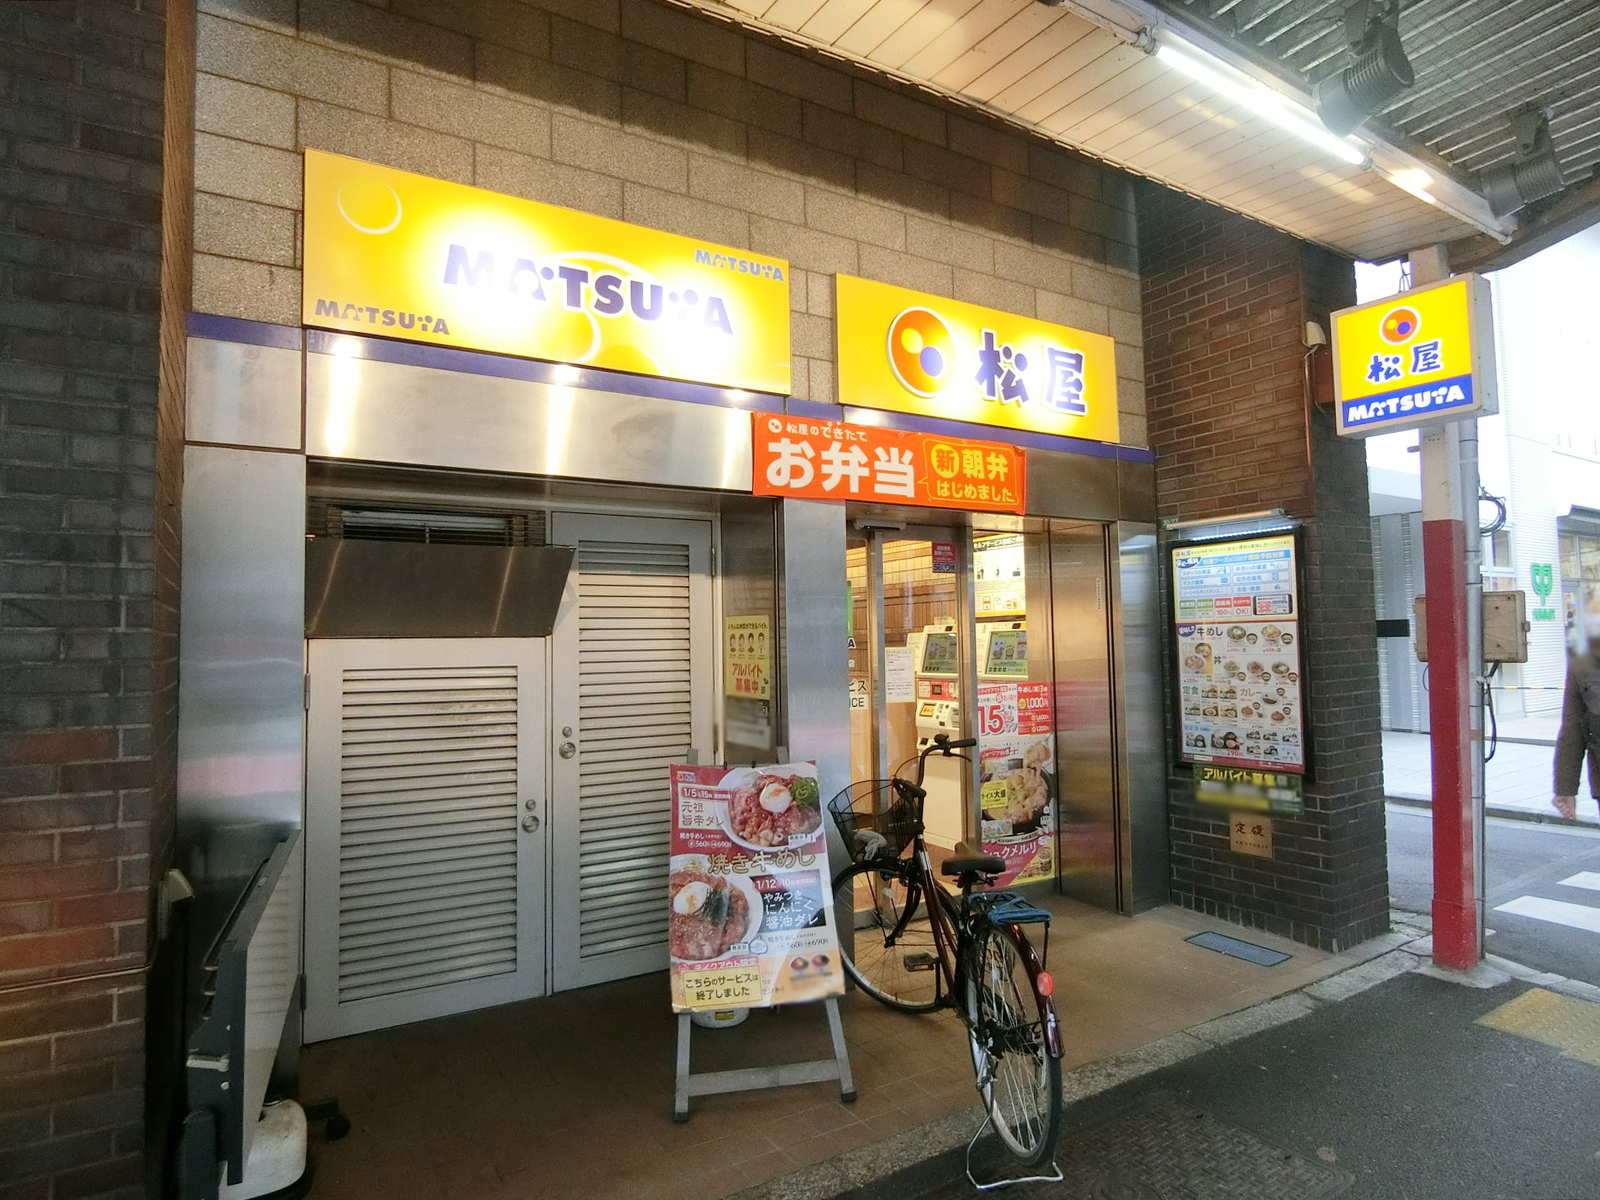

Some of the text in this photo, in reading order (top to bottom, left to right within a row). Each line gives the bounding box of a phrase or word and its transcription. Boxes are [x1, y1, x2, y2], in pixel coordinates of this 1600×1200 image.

[695, 249, 784, 281] MATSUYA
[443, 243, 733, 335] MATSUYA
[315, 299, 450, 335] MATSUYA
[1366, 340, 1443, 384] 松屋
[975, 329, 1087, 414] 松屋
[1347, 384, 1465, 422] MATSUYA
[786, 421, 868, 442] 松屋のできたて
[766, 438, 915, 498] お弁当
[936, 481, 1015, 502] はじめました
[1196, 626, 1224, 637] 牛めし
[732, 663, 763, 678] アルバイト
[1182, 686, 1199, 695] 定食
[1240, 688, 1262, 697] カレー
[682, 801, 704, 813] 元祖
[682, 814, 725, 827] 旨辛タレ
[707, 847, 816, 875] 焼き牛めし
[764, 889, 803, 903] やみつき
[765, 899, 815, 915] にんにく
[765, 913, 819, 929] 醤油ダレ
[685, 973, 759, 989] こちらのサービスは
[695, 986, 750, 1001] 終了しました
